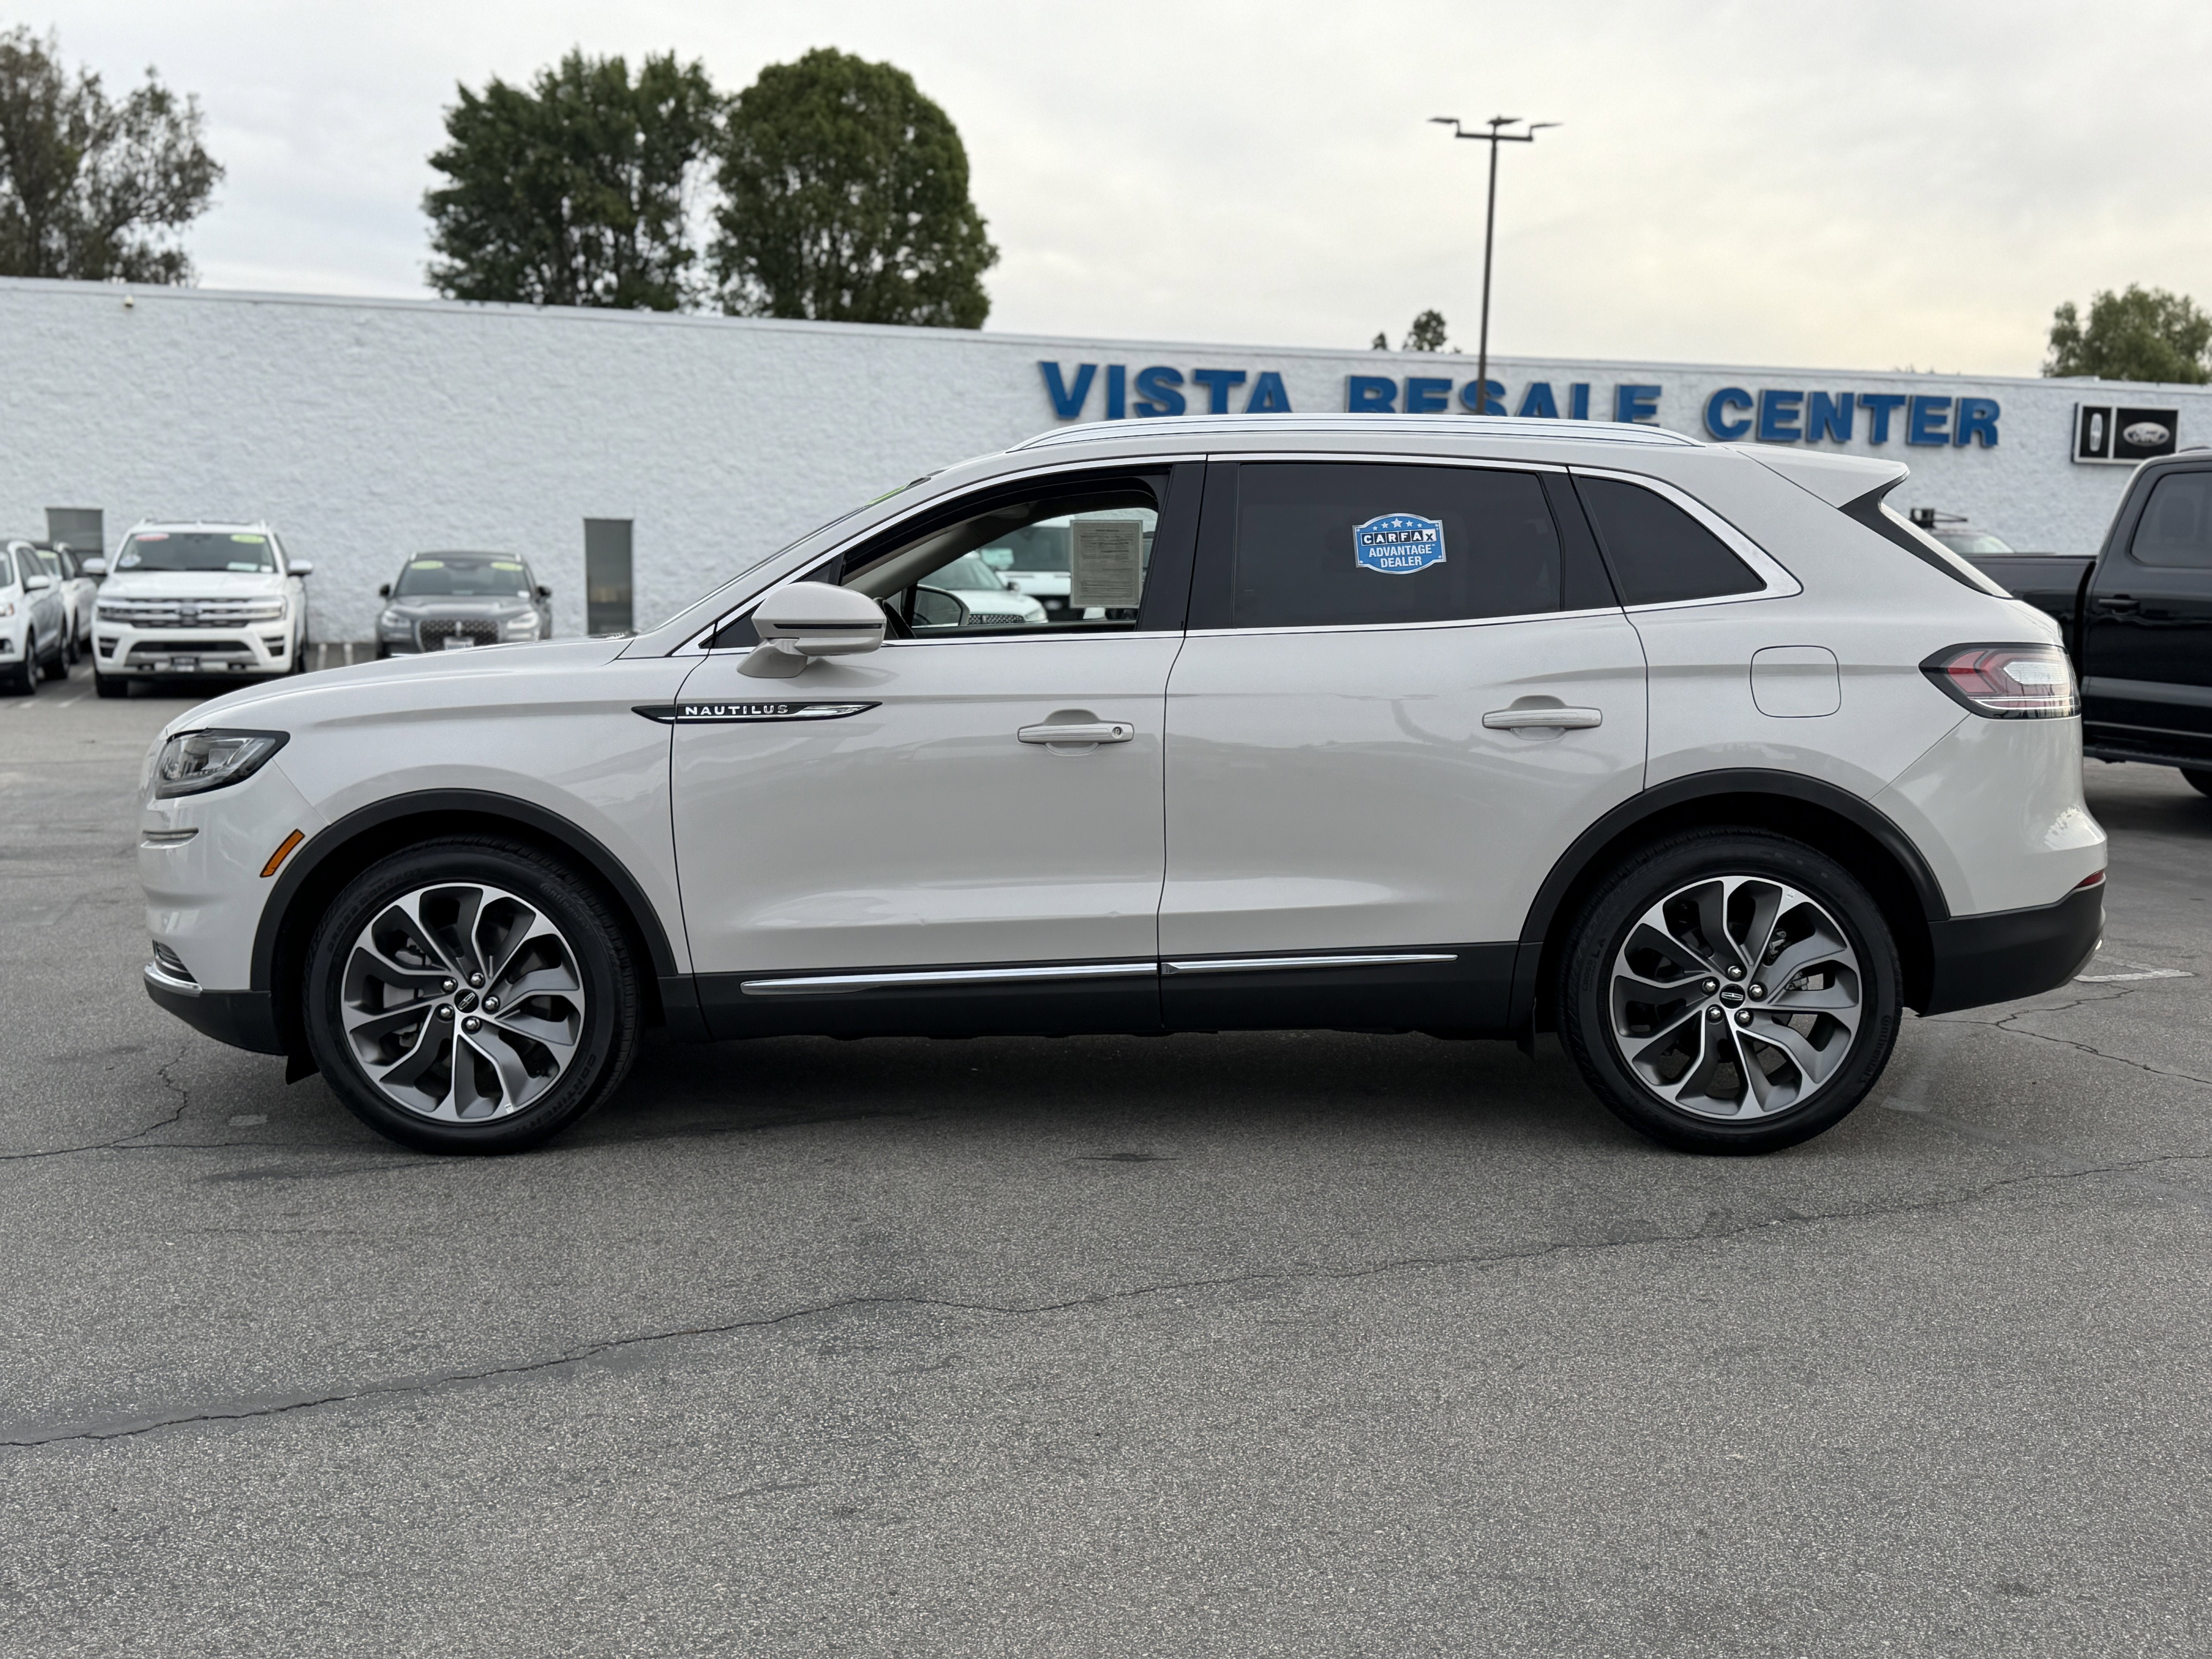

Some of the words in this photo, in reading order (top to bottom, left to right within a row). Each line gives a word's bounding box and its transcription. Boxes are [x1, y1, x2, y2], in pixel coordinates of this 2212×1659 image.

[1038, 361, 1293, 420] VISTA
[1704, 387, 2001, 448] CENTER
[1362, 531, 1436, 544] CARFAX
[1369, 544, 1433, 557] ADVANTAGE
[1380, 556, 1422, 568] DEALER
[685, 704, 788, 716] NAUTILUS
